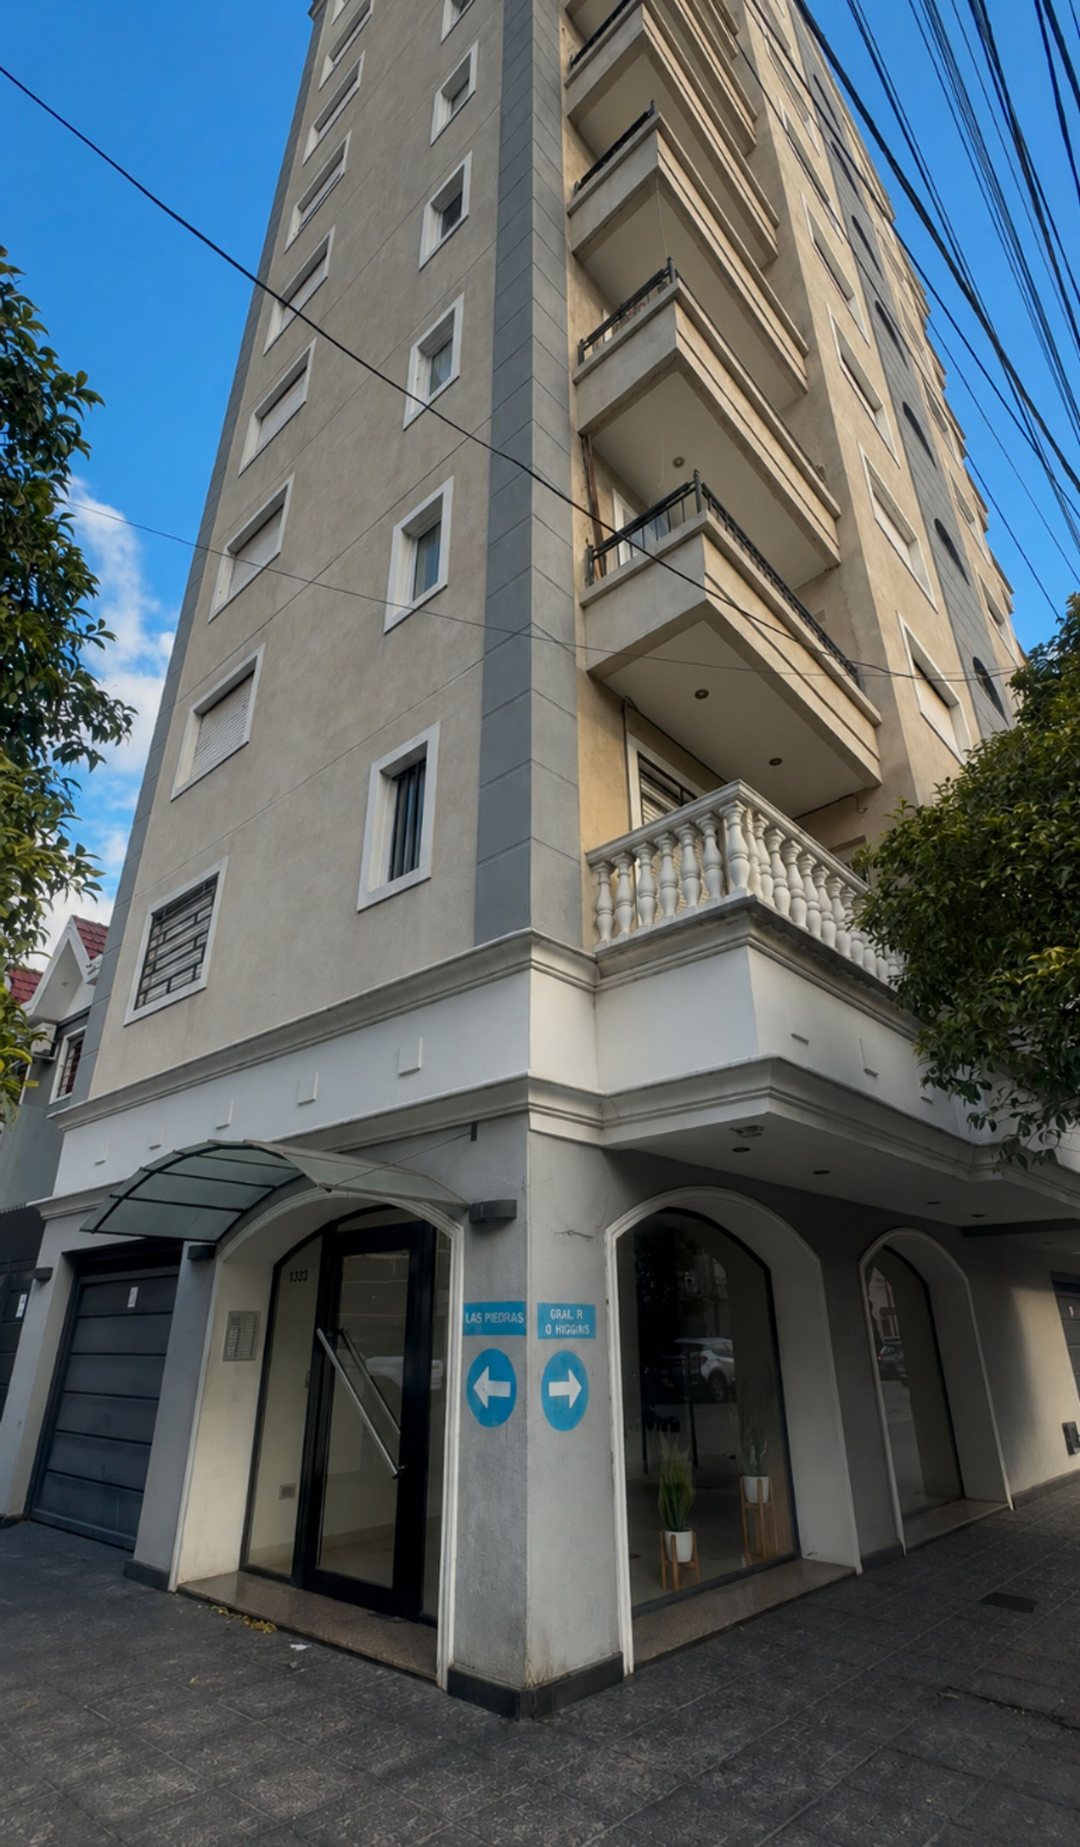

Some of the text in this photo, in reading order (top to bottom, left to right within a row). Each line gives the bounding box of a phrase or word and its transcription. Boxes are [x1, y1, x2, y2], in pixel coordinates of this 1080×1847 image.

[465, 1312, 524, 1324] LAS PIEDRAS
[555, 1323, 590, 1335] HIGGINS
